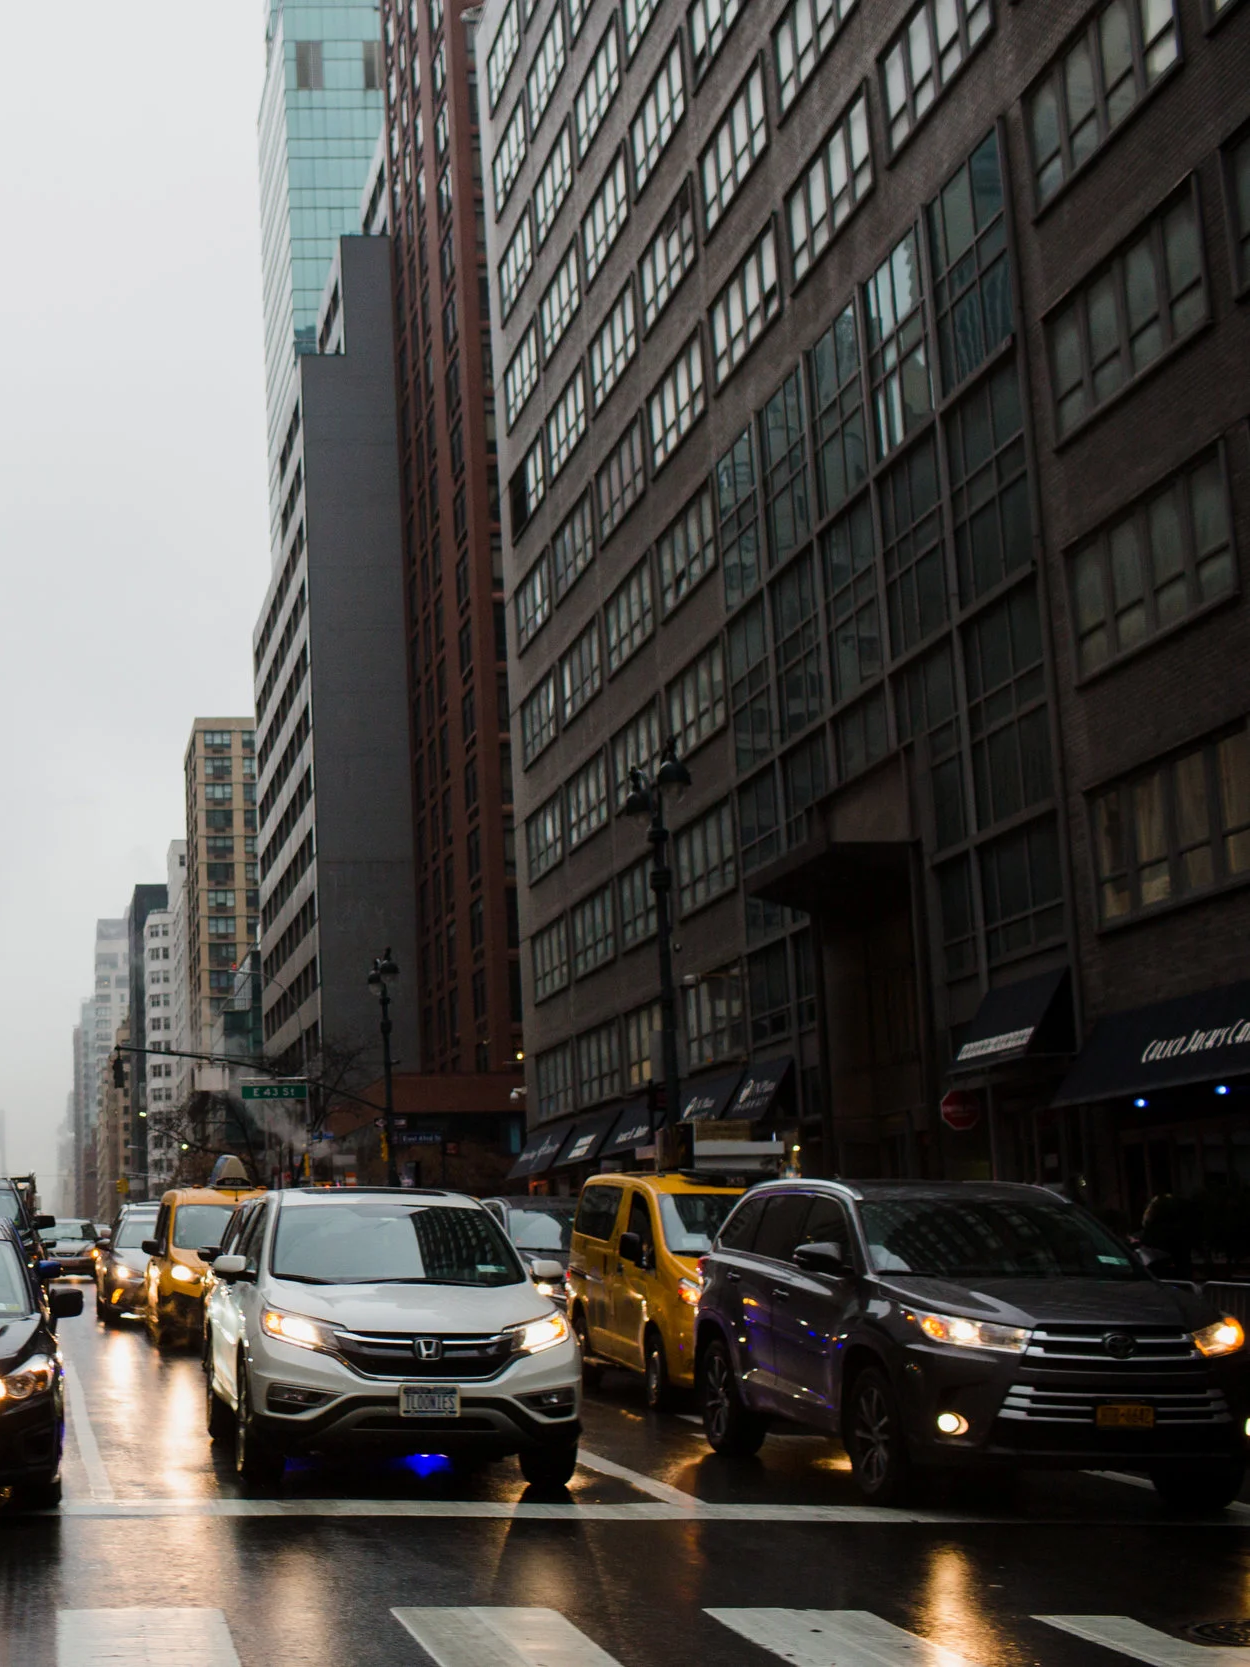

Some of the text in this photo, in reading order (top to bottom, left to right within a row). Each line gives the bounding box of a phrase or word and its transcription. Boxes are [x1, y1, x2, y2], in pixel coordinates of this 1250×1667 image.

[253, 1088, 295, 1097] E 43 St
